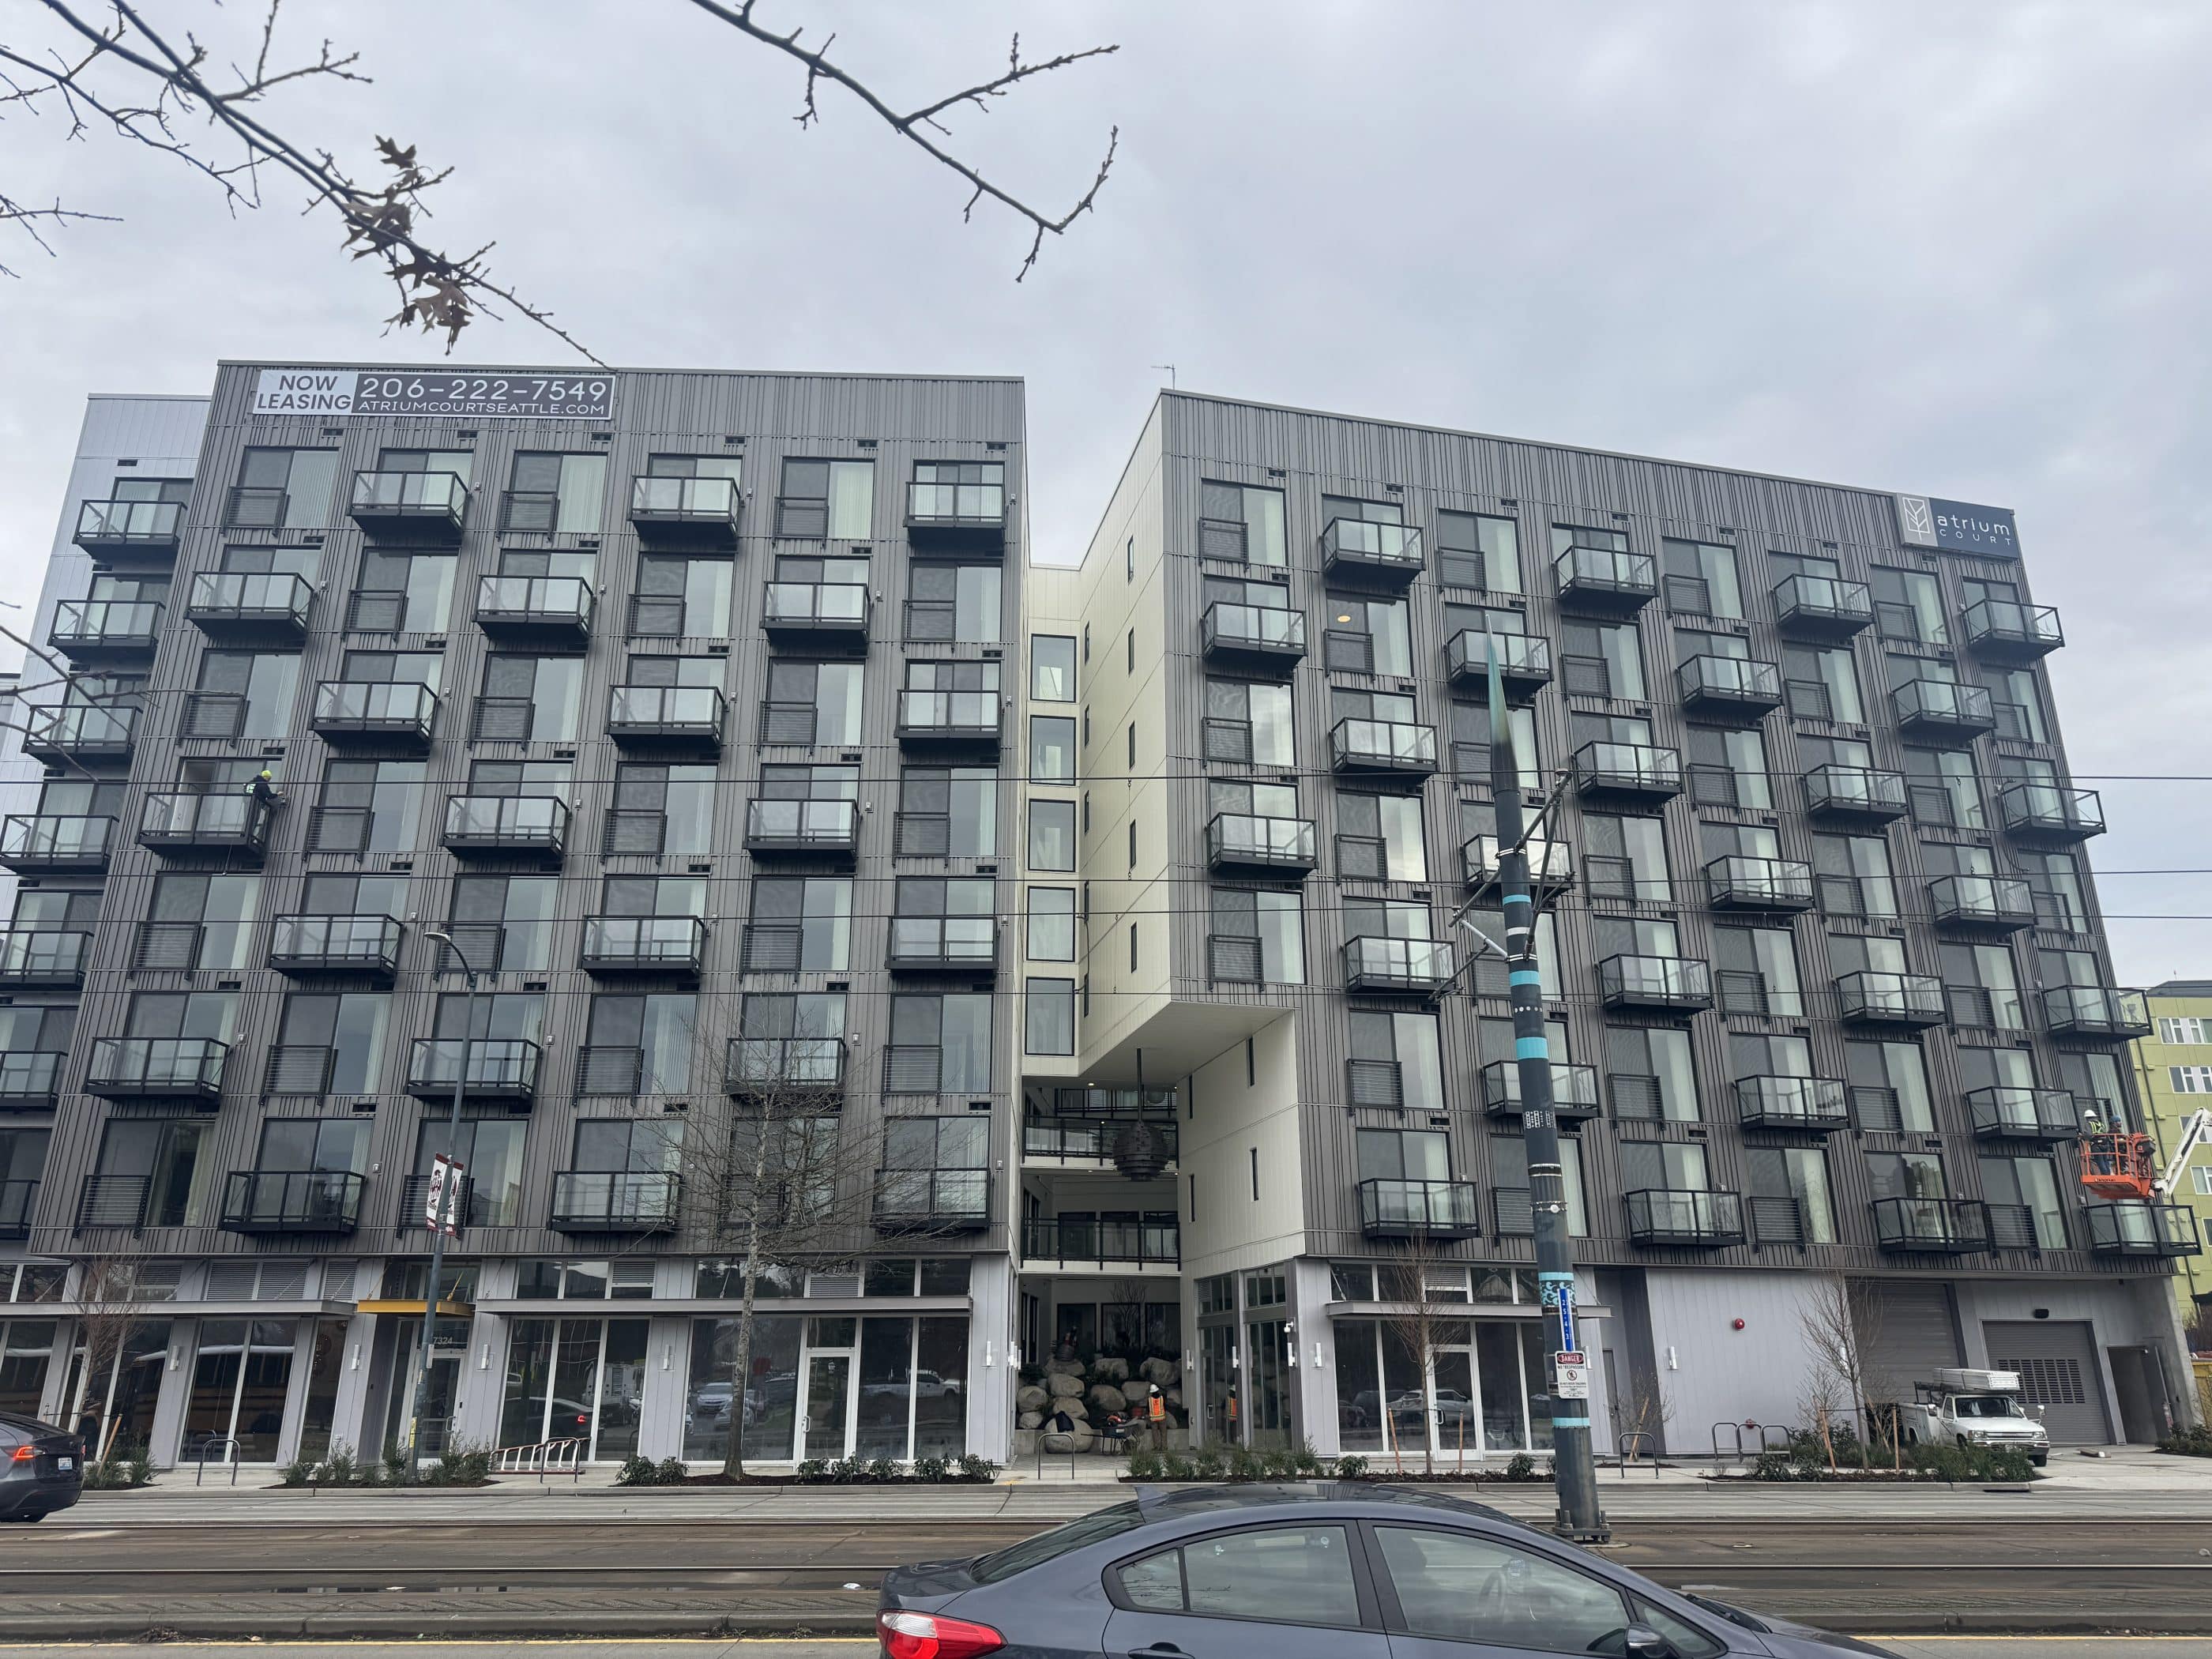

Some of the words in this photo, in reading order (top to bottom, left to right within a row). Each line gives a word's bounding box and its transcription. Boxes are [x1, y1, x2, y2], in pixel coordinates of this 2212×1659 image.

[279, 375, 338, 391] NOW
[360, 378, 606, 401] 206-222-7549
[258, 393, 351, 409] LEASING
[359, 401, 604, 415] ATRIUMCOURTSEATTLE.COM
[1937, 514, 2010, 536] atrium
[1939, 529, 2011, 545] COURT
